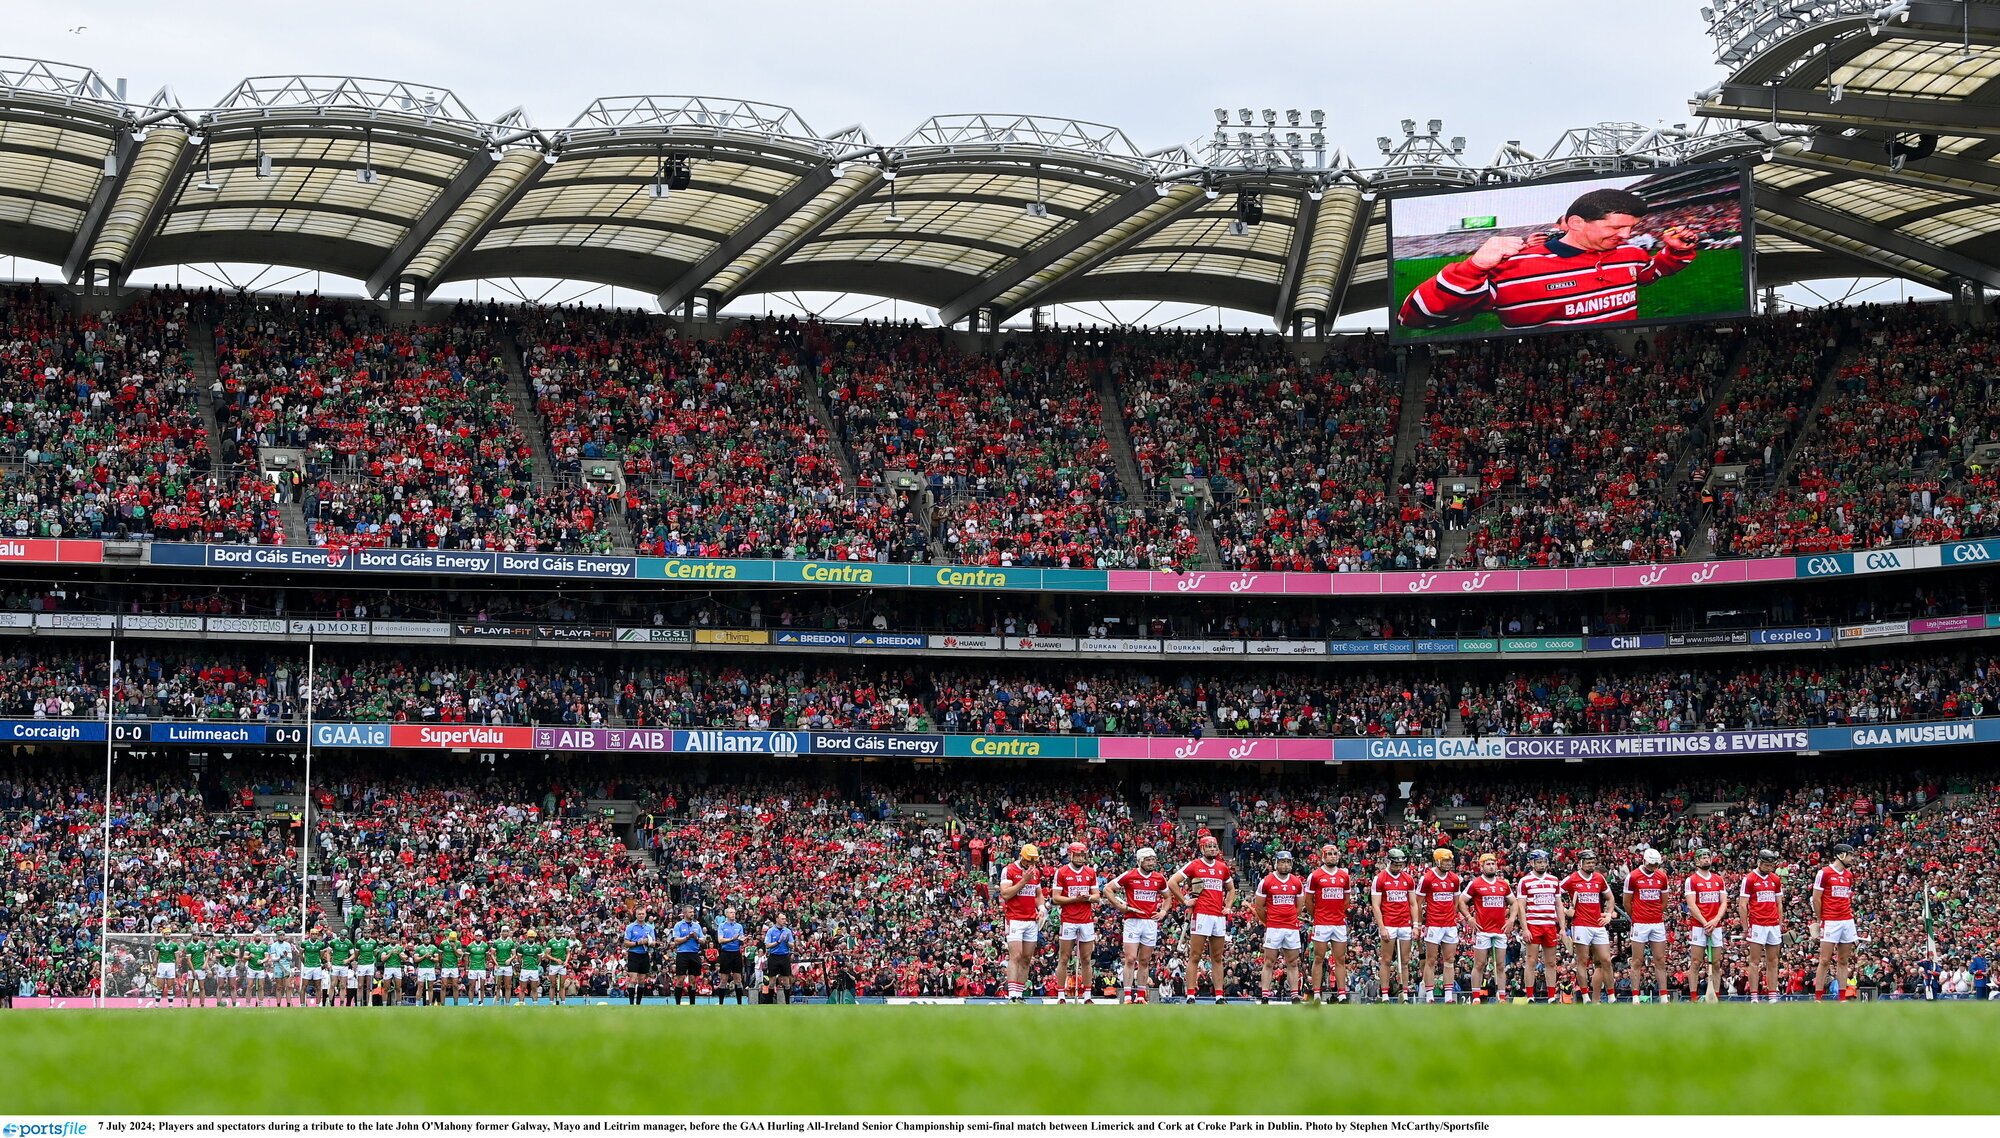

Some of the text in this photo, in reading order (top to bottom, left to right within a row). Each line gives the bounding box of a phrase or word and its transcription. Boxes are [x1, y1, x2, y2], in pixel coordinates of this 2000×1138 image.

[214, 549, 347, 568] Bord Gáis Energy
[360, 552, 490, 571] Bord Gáis Energy
[1866, 552, 1901, 569] GAA
[1953, 543, 1990, 562] GAA
[503, 557, 631, 576] Bord Gáis Energy
[664, 560, 737, 579] Centra
[801, 563, 873, 582] Centra
[1691, 563, 1719, 583] eir
[1807, 557, 1842, 574] GAA
[936, 567, 1006, 586] Centra
[1177, 572, 1206, 592] eir
[1229, 572, 1258, 592] eir
[1408, 572, 1438, 592] eir
[1462, 571, 1491, 591] eir
[1640, 565, 1667, 586] eir
[386, 625, 431, 633] conditioning
[651, 630, 688, 638] DGSL
[800, 634, 846, 645] BREEDON
[876, 636, 921, 646] BREEDON
[959, 640, 987, 648] HUAWEI
[1034, 641, 1062, 649] HUAWEI
[1349, 643, 1369, 653] Sport
[1389, 642, 1410, 653] Sport
[1434, 642, 1455, 652] Sport
[1611, 636, 1641, 649] Chill
[13, 725, 80, 741] Corcaigh
[169, 727, 249, 741] Luimneach
[318, 726, 385, 745] GAA.ie
[420, 727, 504, 747] SuperValu
[558, 730, 595, 748] AIB
[628, 732, 665, 750] AIB
[684, 731, 764, 752] Allianz
[1853, 723, 1974, 745] GAA MUSEUM
[816, 735, 939, 753] Bord Gáis Energy
[970, 737, 1040, 756] Centra
[1175, 738, 1204, 758] eir
[1228, 738, 1258, 759] eir
[1370, 740, 1433, 758] GAA.ie
[1438, 739, 1502, 757] GAA.ie
[1506, 732, 1808, 756] CROKE PARK MEETINGS & EVENTS
